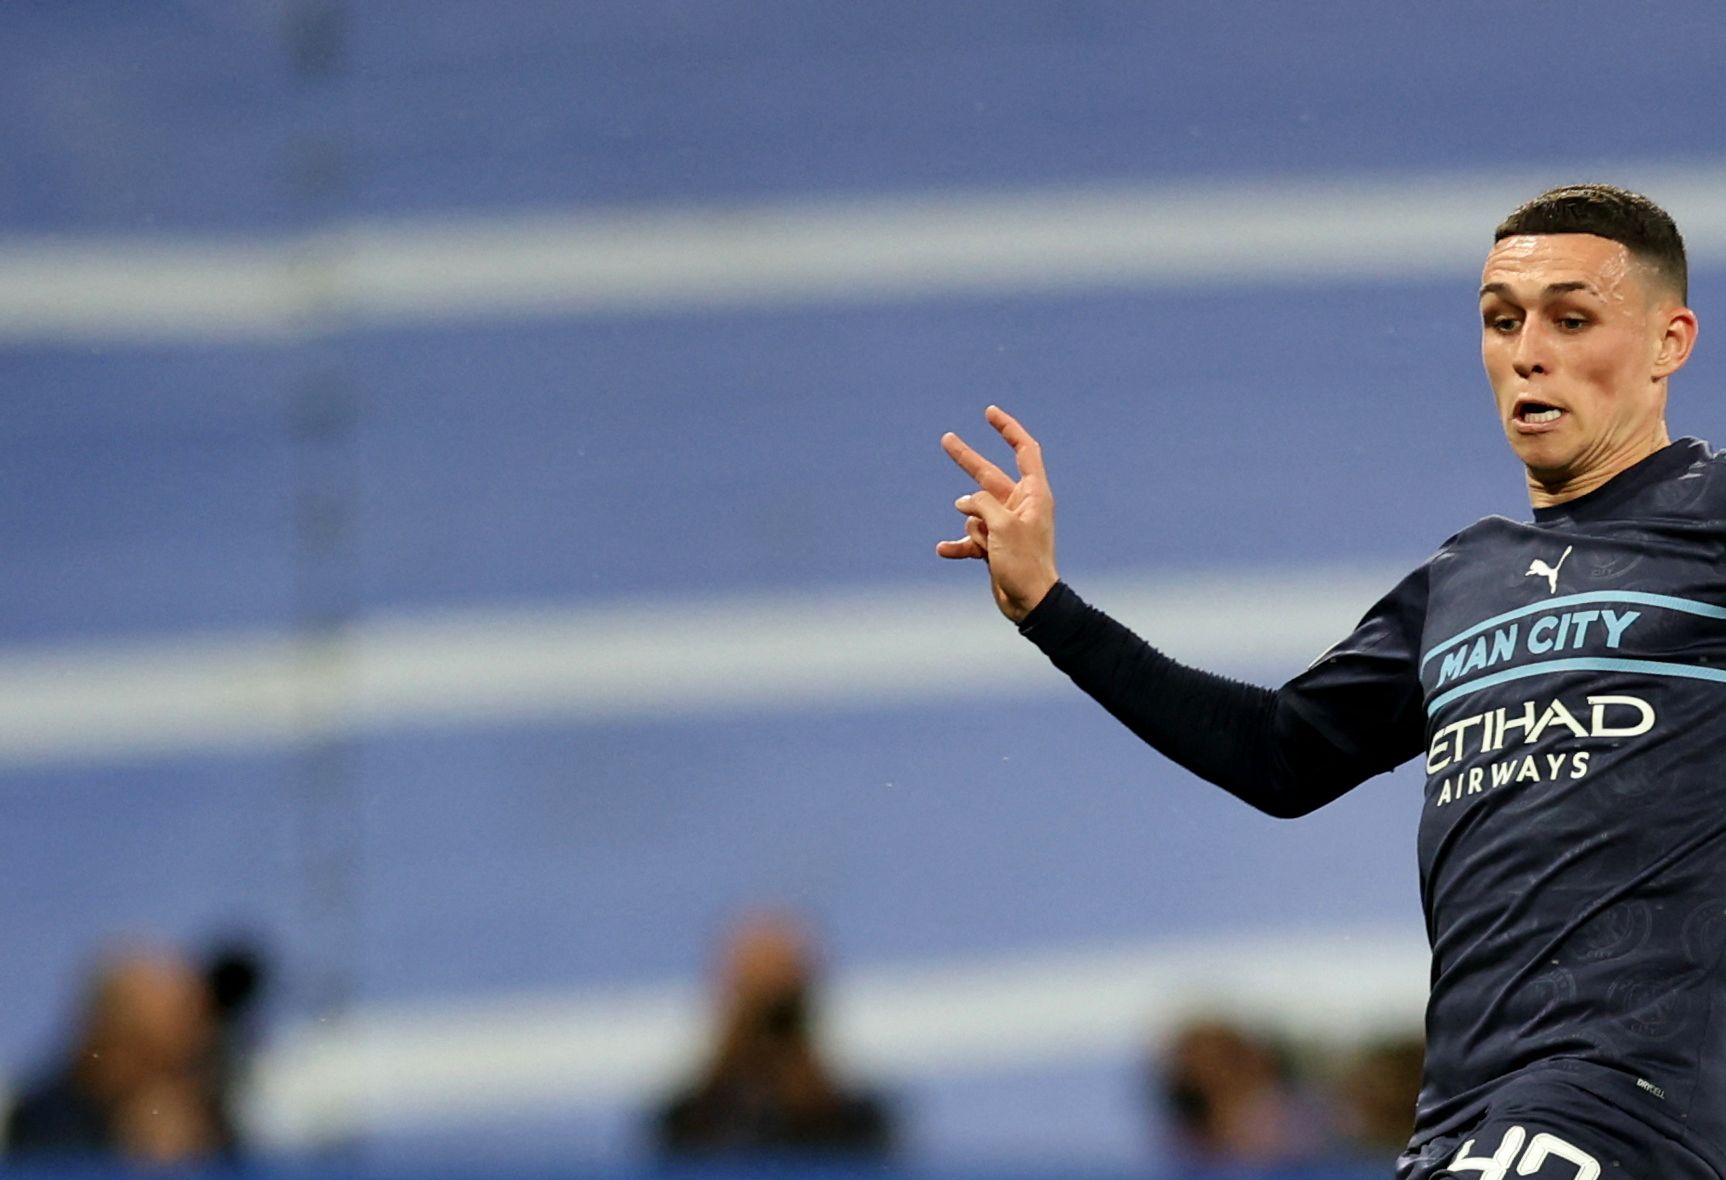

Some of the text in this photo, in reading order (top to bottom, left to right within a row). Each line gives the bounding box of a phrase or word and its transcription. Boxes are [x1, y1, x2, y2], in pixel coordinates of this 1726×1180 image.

[1435, 609, 1641, 688] MAN CITY
[1426, 695, 1656, 775] ETIHAD
[1437, 751, 1591, 806] AIRWAYS
